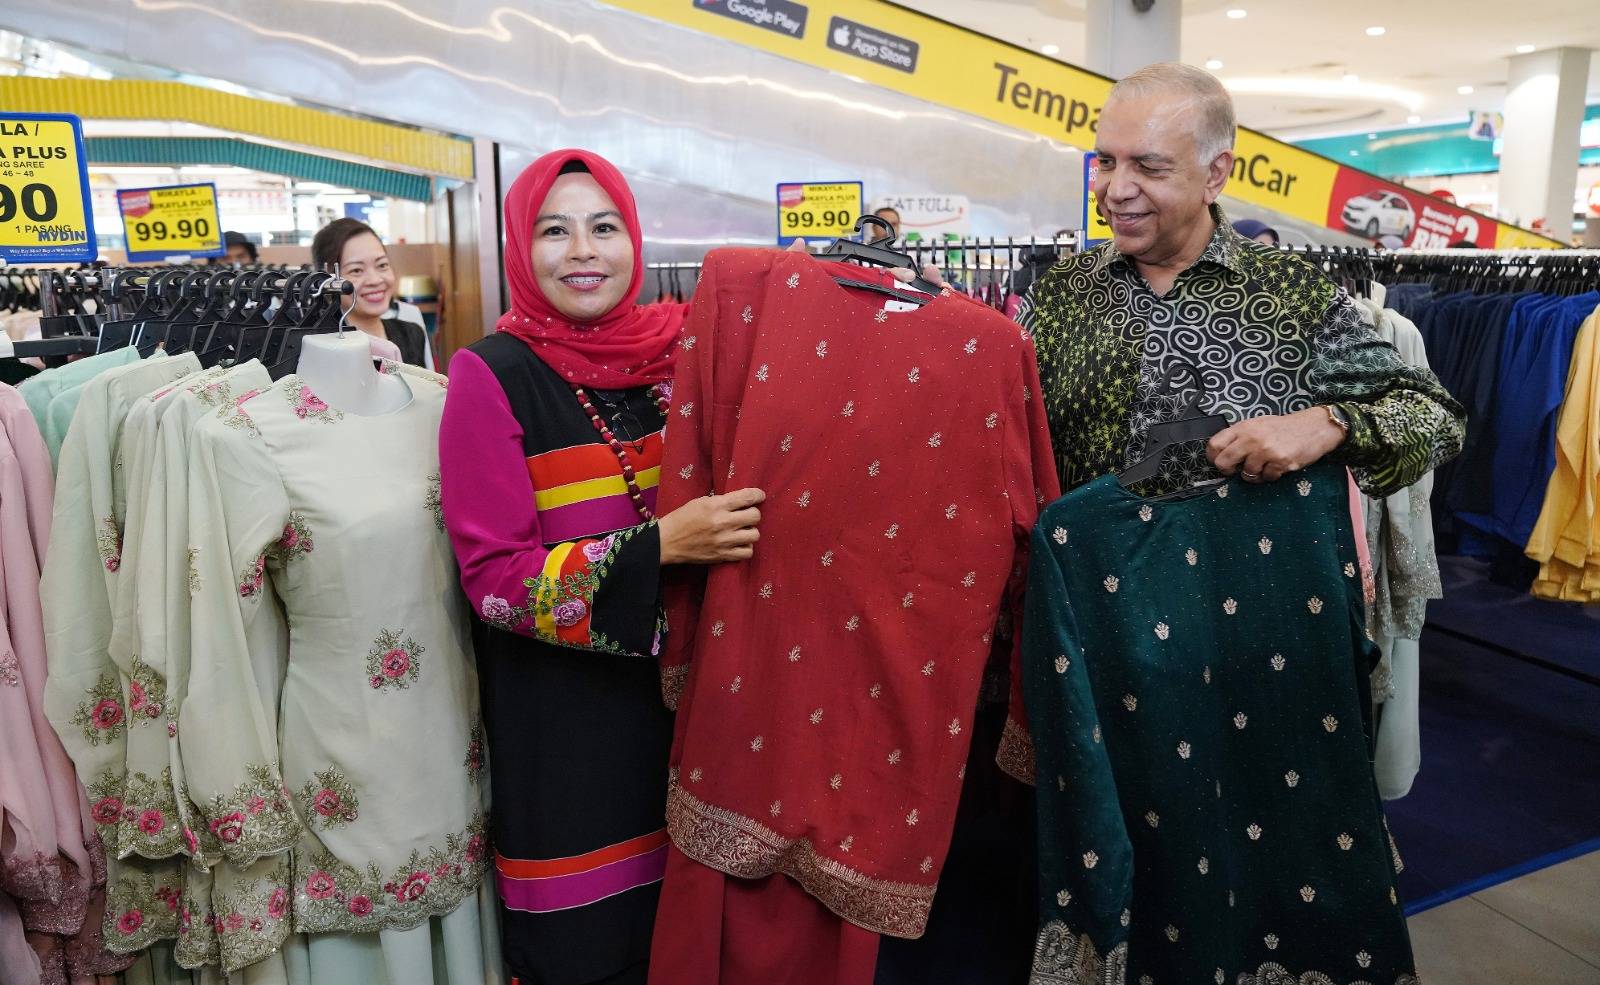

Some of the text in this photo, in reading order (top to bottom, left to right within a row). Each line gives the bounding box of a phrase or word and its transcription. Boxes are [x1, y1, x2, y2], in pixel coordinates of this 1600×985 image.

[727, 0, 800, 34] Google Play
[851, 37, 912, 67] App Store
[13, 146, 67, 159] PLUS
[157, 189, 196, 197] MIKAYLA
[786, 210, 850, 228] 99.90
[15, 225, 72, 233] 1 PASANG
[38, 230, 86, 242] MYDIN
[136, 218, 209, 241] 99.90
